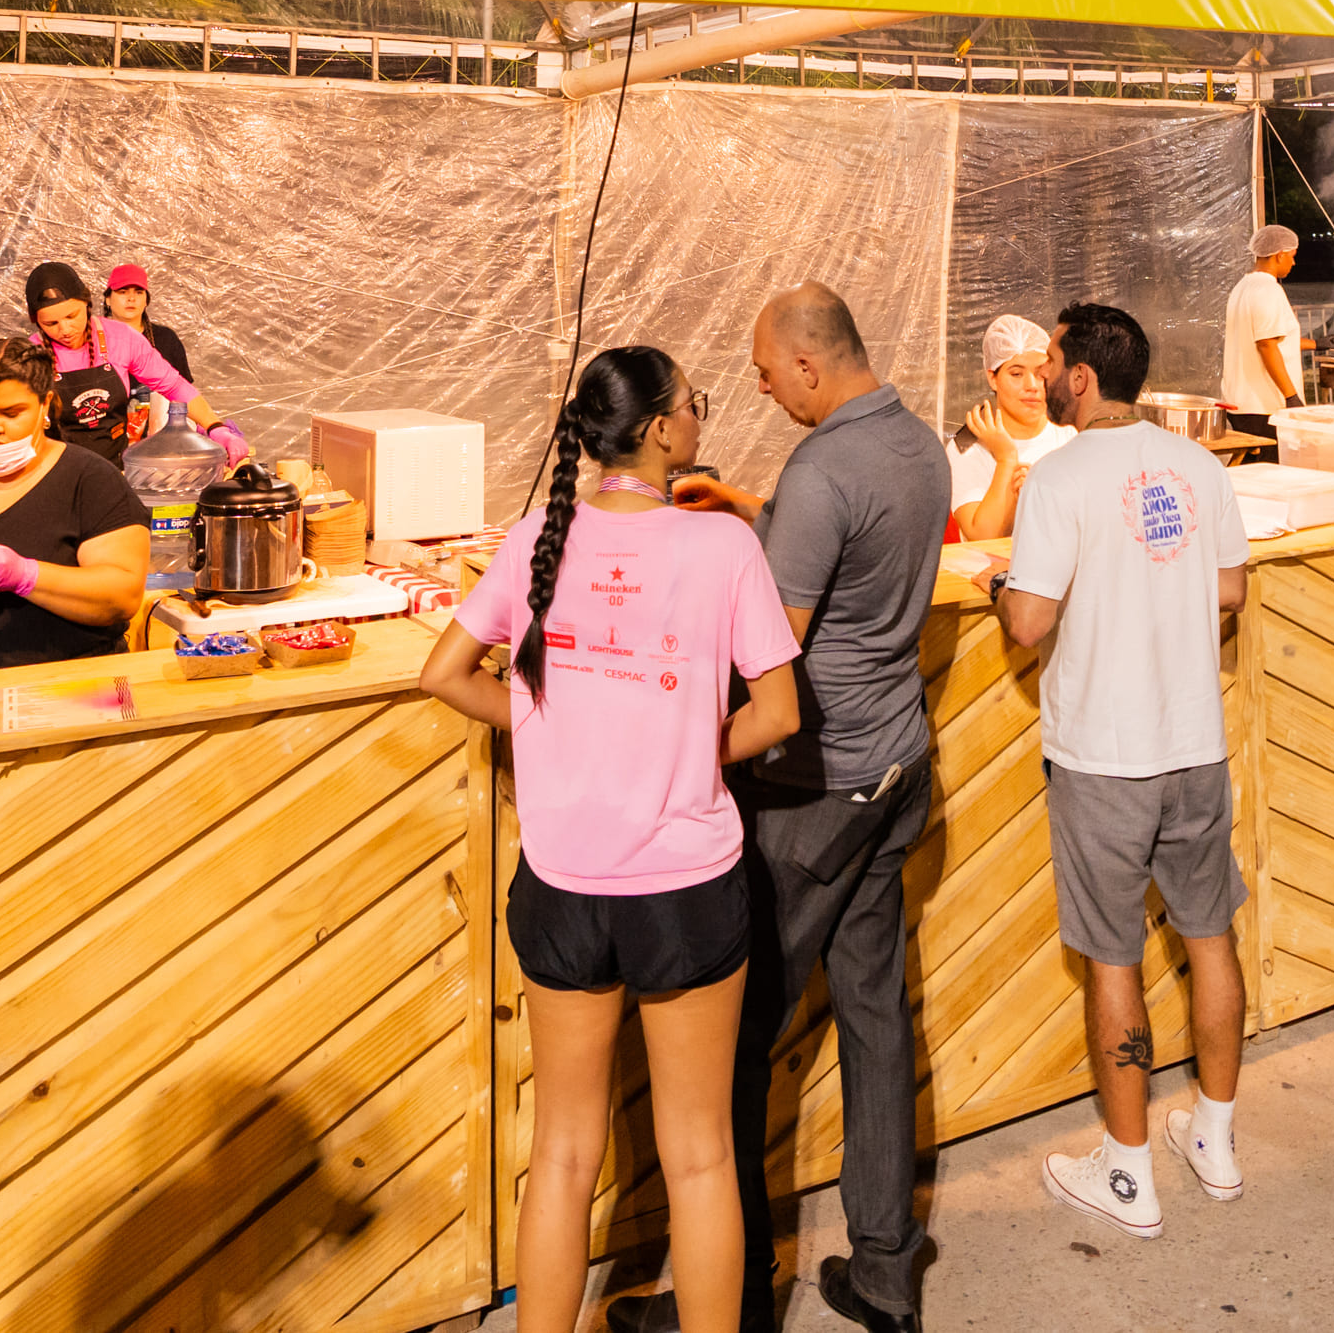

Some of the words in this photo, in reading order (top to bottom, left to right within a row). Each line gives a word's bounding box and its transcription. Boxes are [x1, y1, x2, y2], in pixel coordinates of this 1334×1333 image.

[591, 582, 642, 594] Heineken
[588, 644, 634, 658] LIGHTHOUSE
[604, 669, 647, 683] CESMAC
